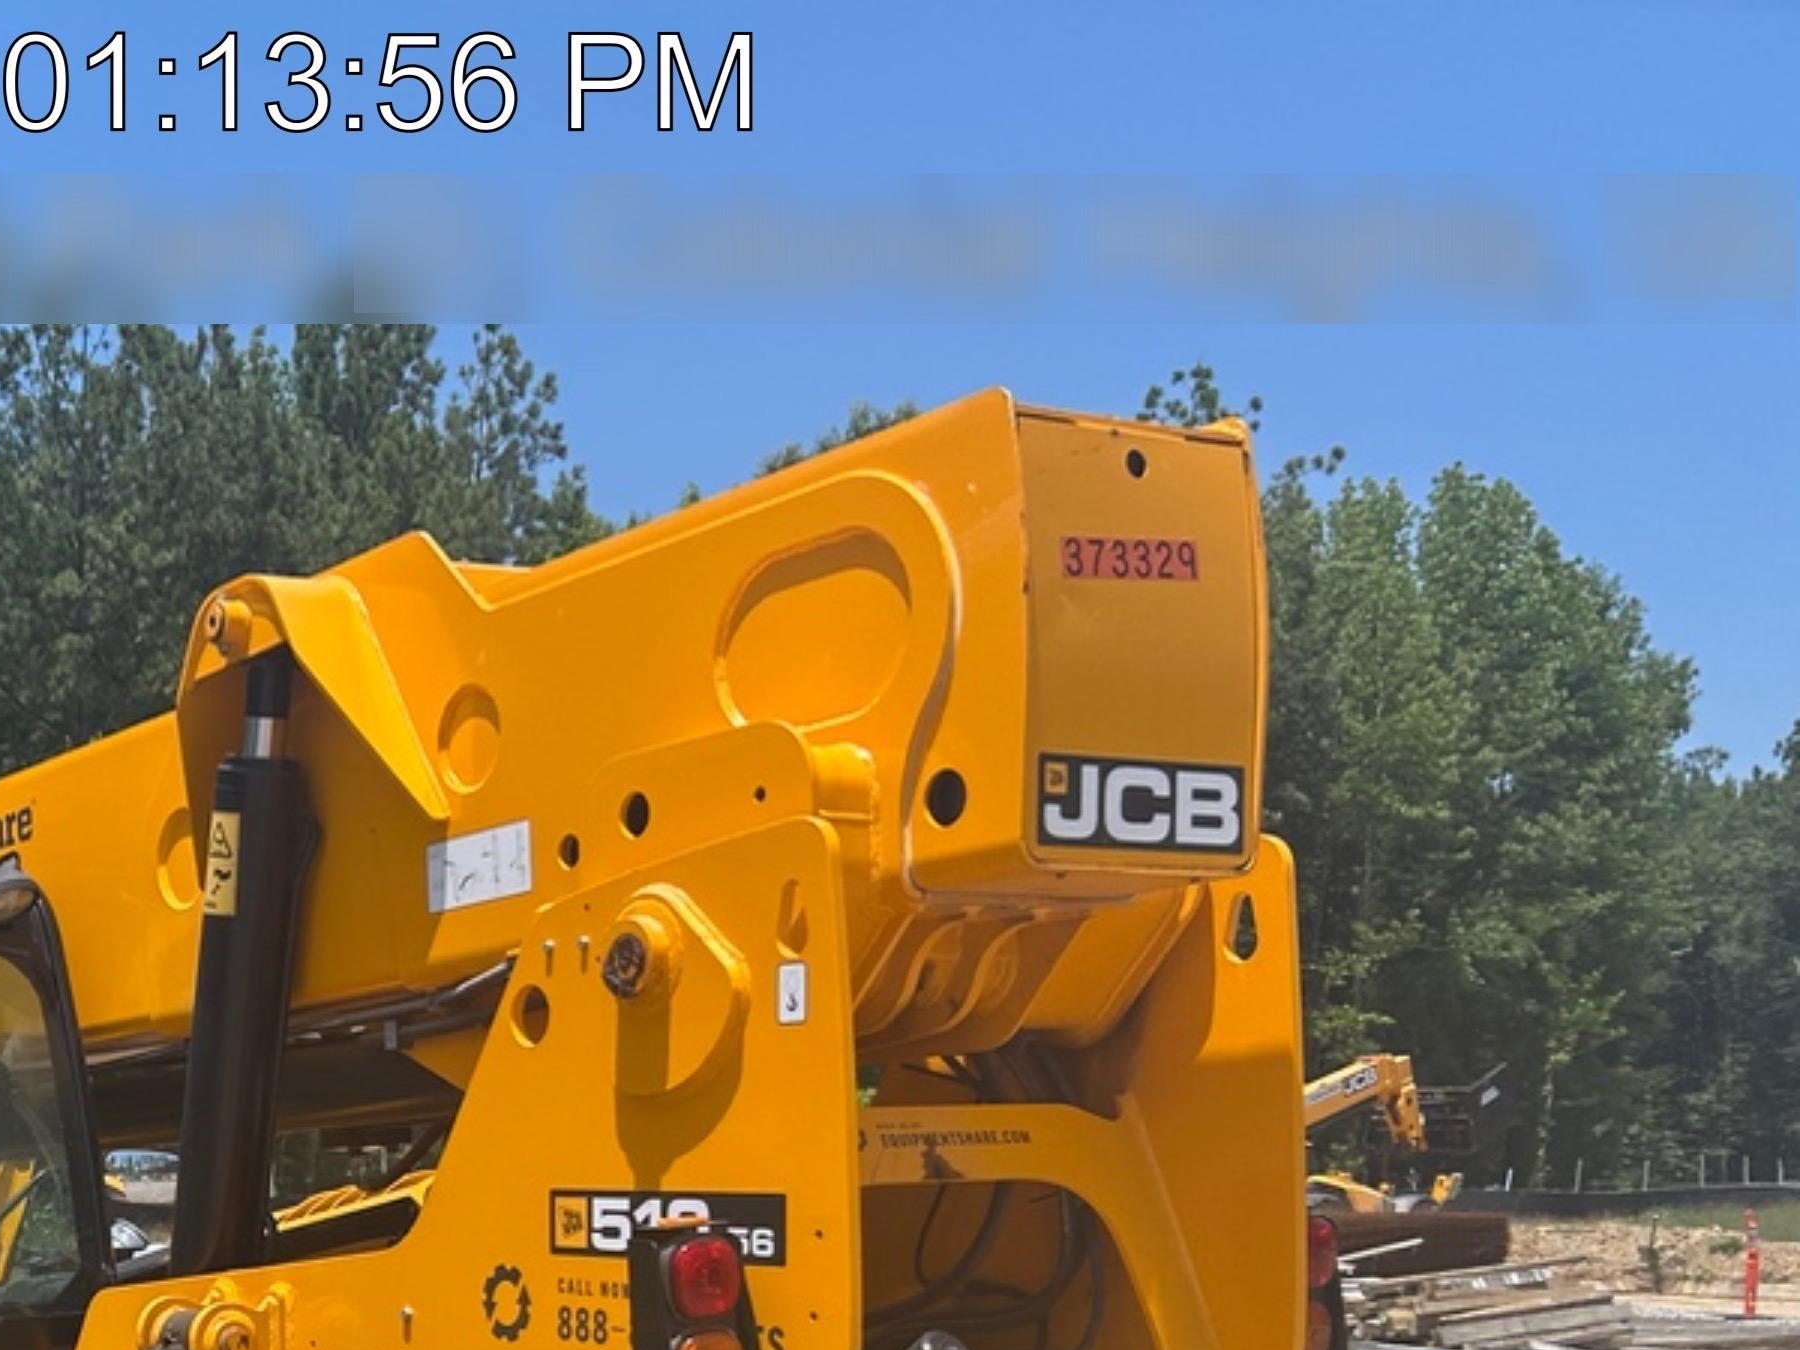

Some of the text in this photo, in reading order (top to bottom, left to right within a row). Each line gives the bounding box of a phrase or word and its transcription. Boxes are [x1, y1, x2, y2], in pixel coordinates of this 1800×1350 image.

[1064, 537, 1198, 580] 373329
[1043, 763, 1240, 846] JCB
[557, 1277, 593, 1297] CALL
